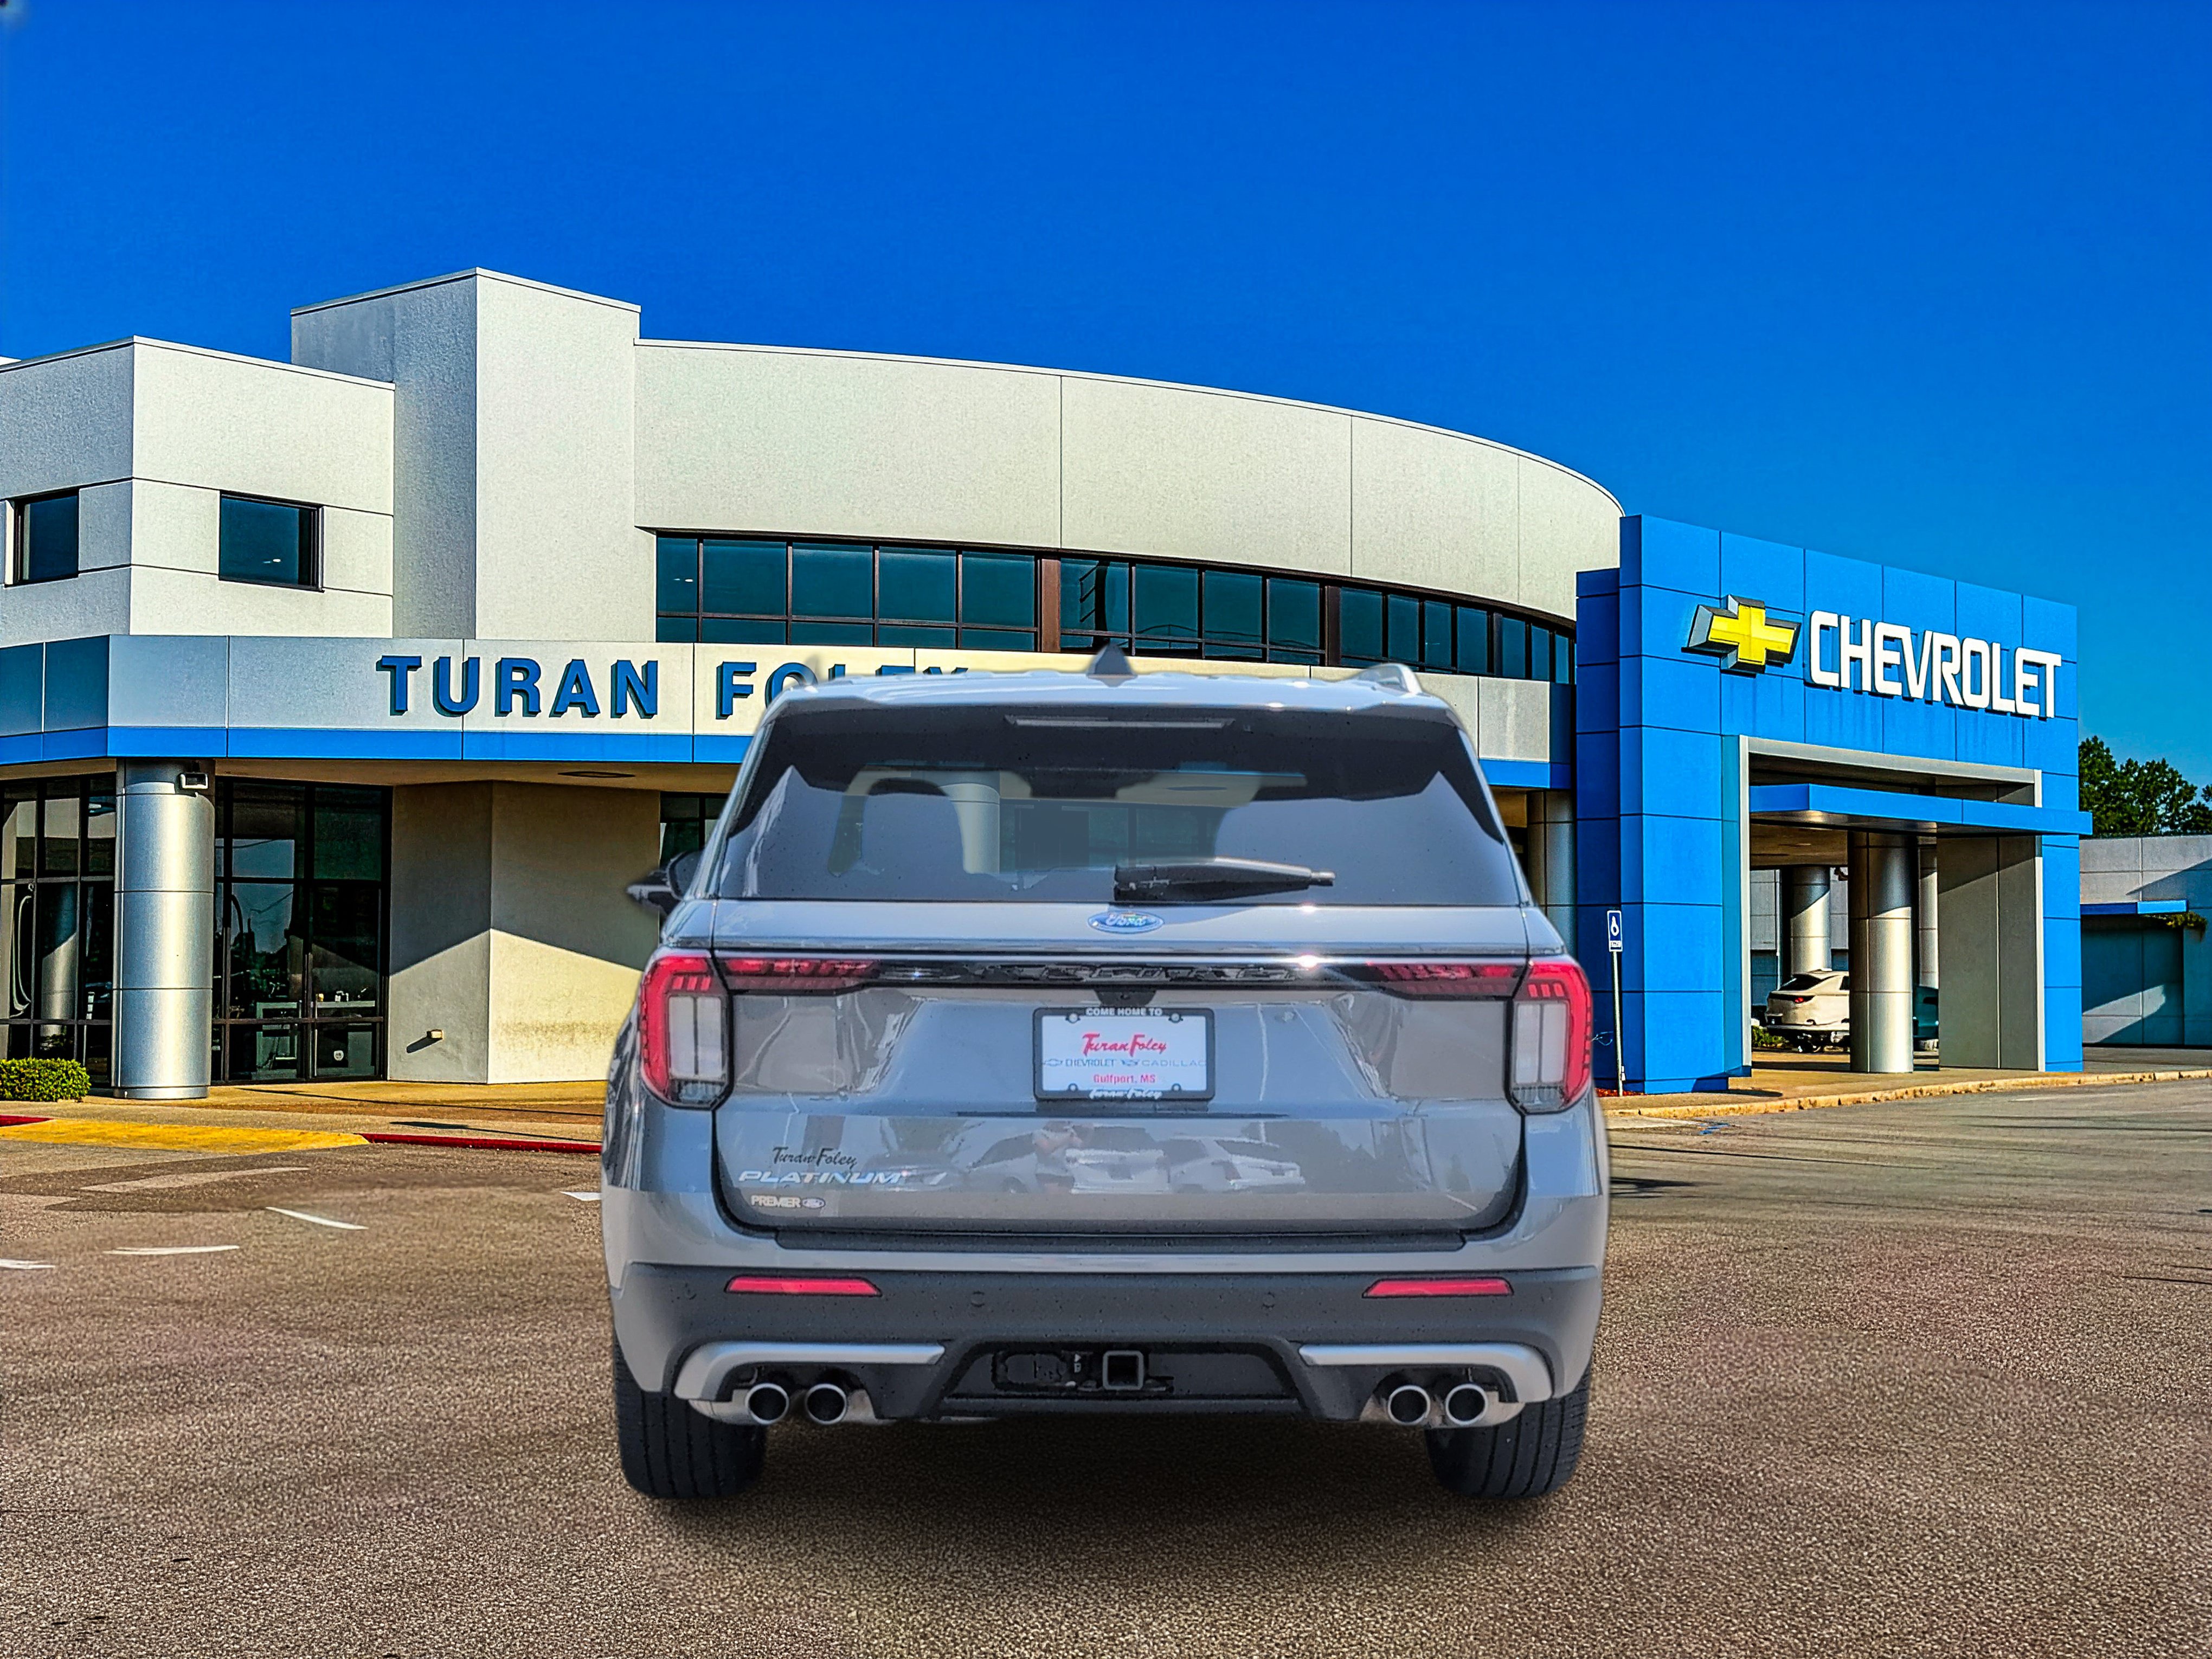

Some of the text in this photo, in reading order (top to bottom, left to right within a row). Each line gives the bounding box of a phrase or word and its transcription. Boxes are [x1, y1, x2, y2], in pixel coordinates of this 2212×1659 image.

[1810, 610, 2062, 718] CHEVROLET
[377, 655, 659, 718] TURAN
[1085, 1007, 1162, 1016] COME HOME TO
[1065, 1059, 1114, 1067] CHEVROLET
[1140, 1074, 1155, 1083] MS
[738, 1171, 901, 1184] PLATINUM
[751, 1195, 801, 1208] PREMIER
